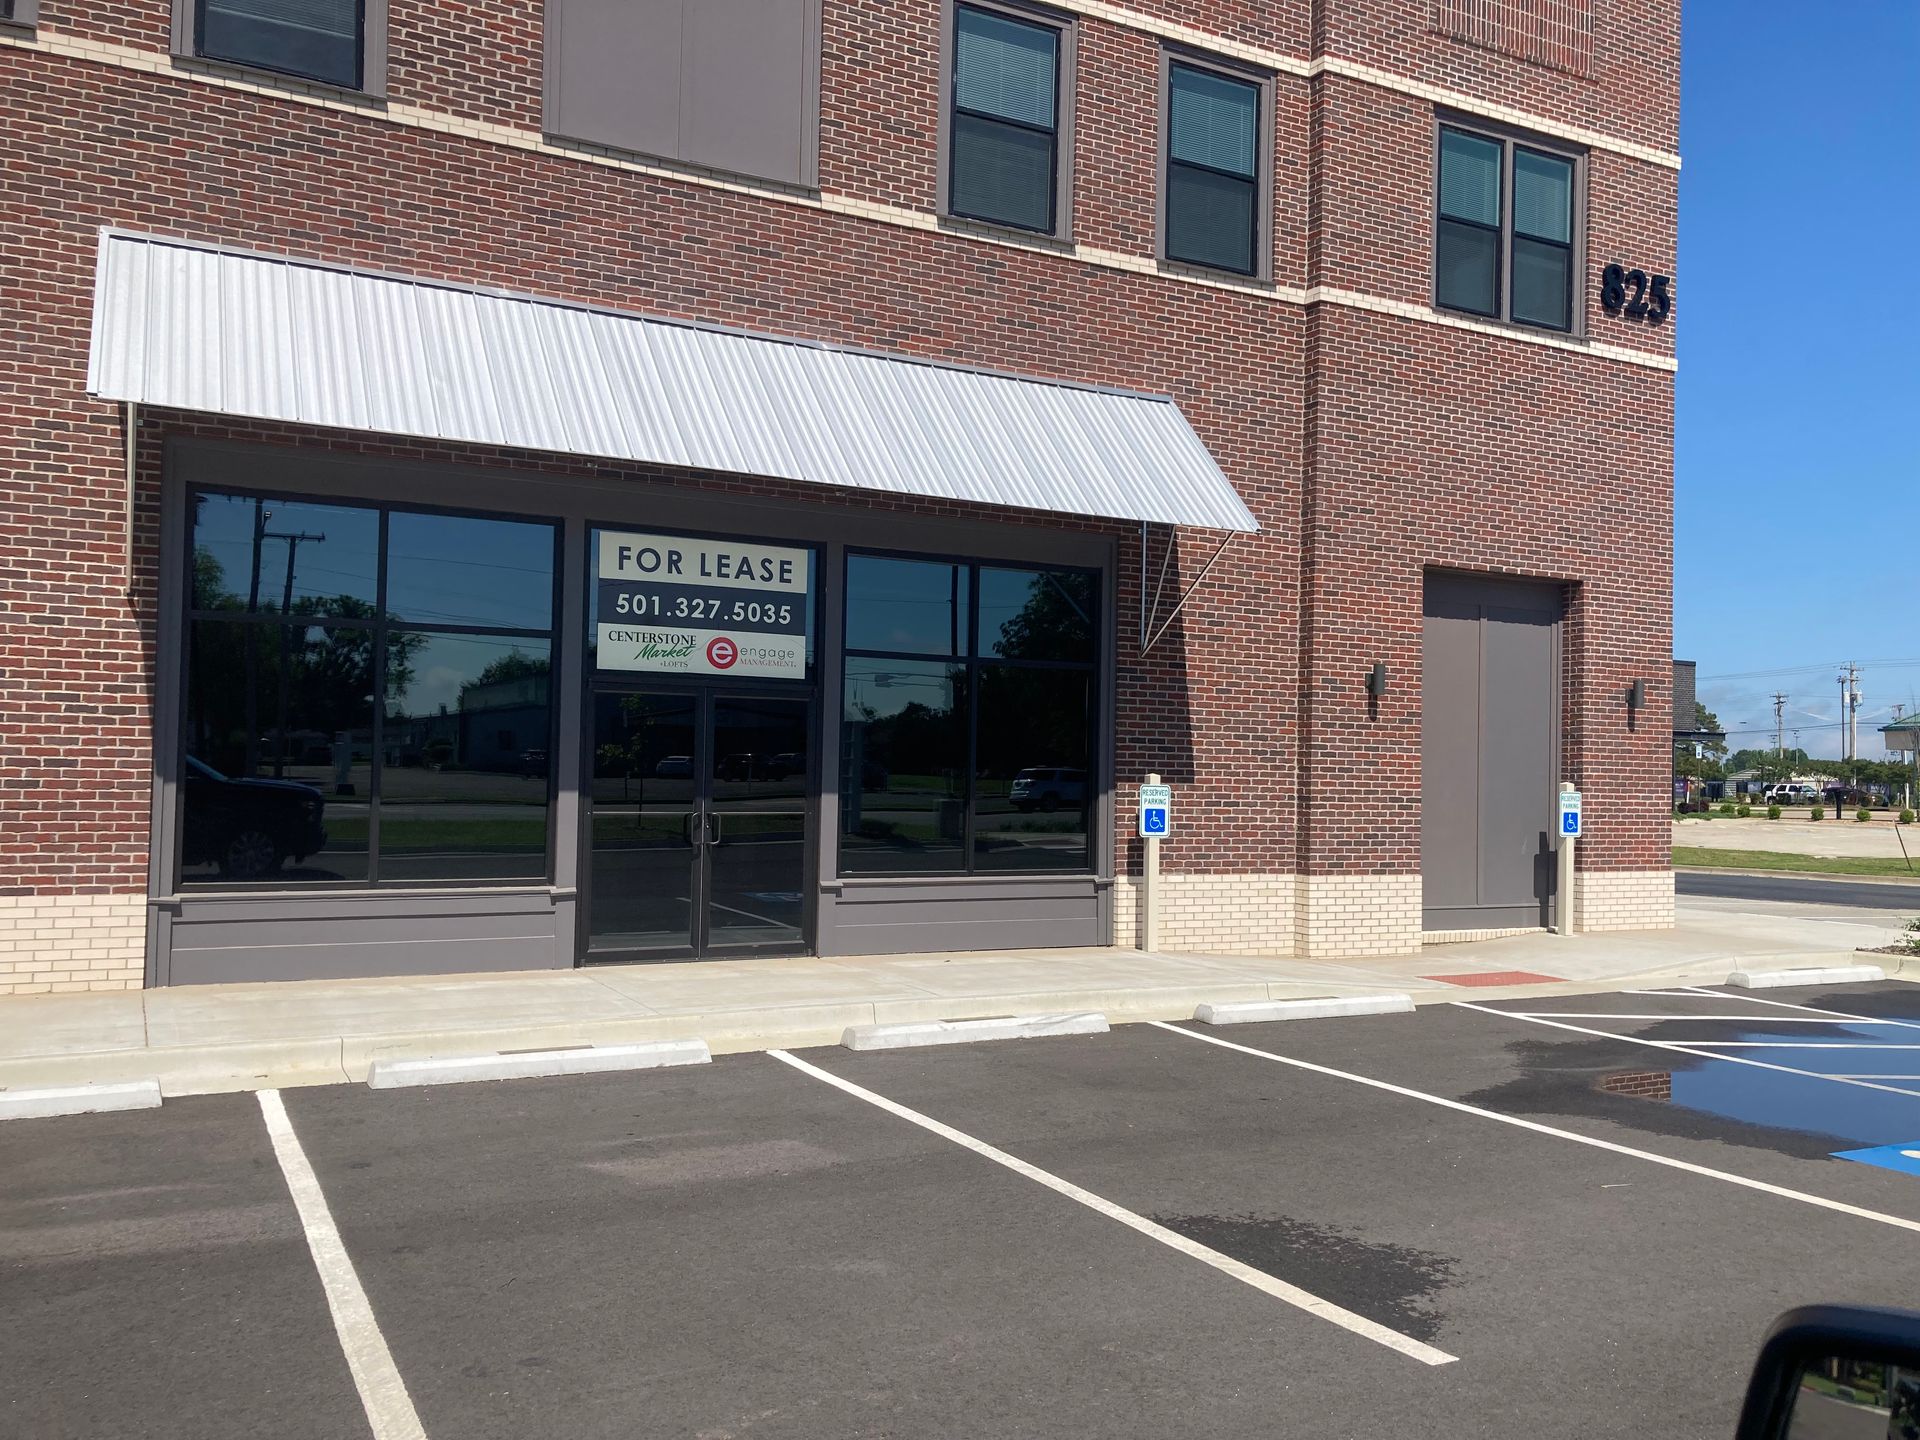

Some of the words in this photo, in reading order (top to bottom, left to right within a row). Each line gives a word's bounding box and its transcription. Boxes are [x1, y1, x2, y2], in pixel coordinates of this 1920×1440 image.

[1601, 264, 1671, 322] 825
[618, 546, 683, 575] FOR
[700, 552, 793, 584] LEASE
[615, 593, 792, 625] 501.327.5035
[608, 630, 697, 646] CENTERSTONE
[633, 642, 697, 660] Market
[740, 647, 795, 660] engage
[1142, 788, 1169, 797] RESERVED
[1143, 798, 1167, 806] PARKING
